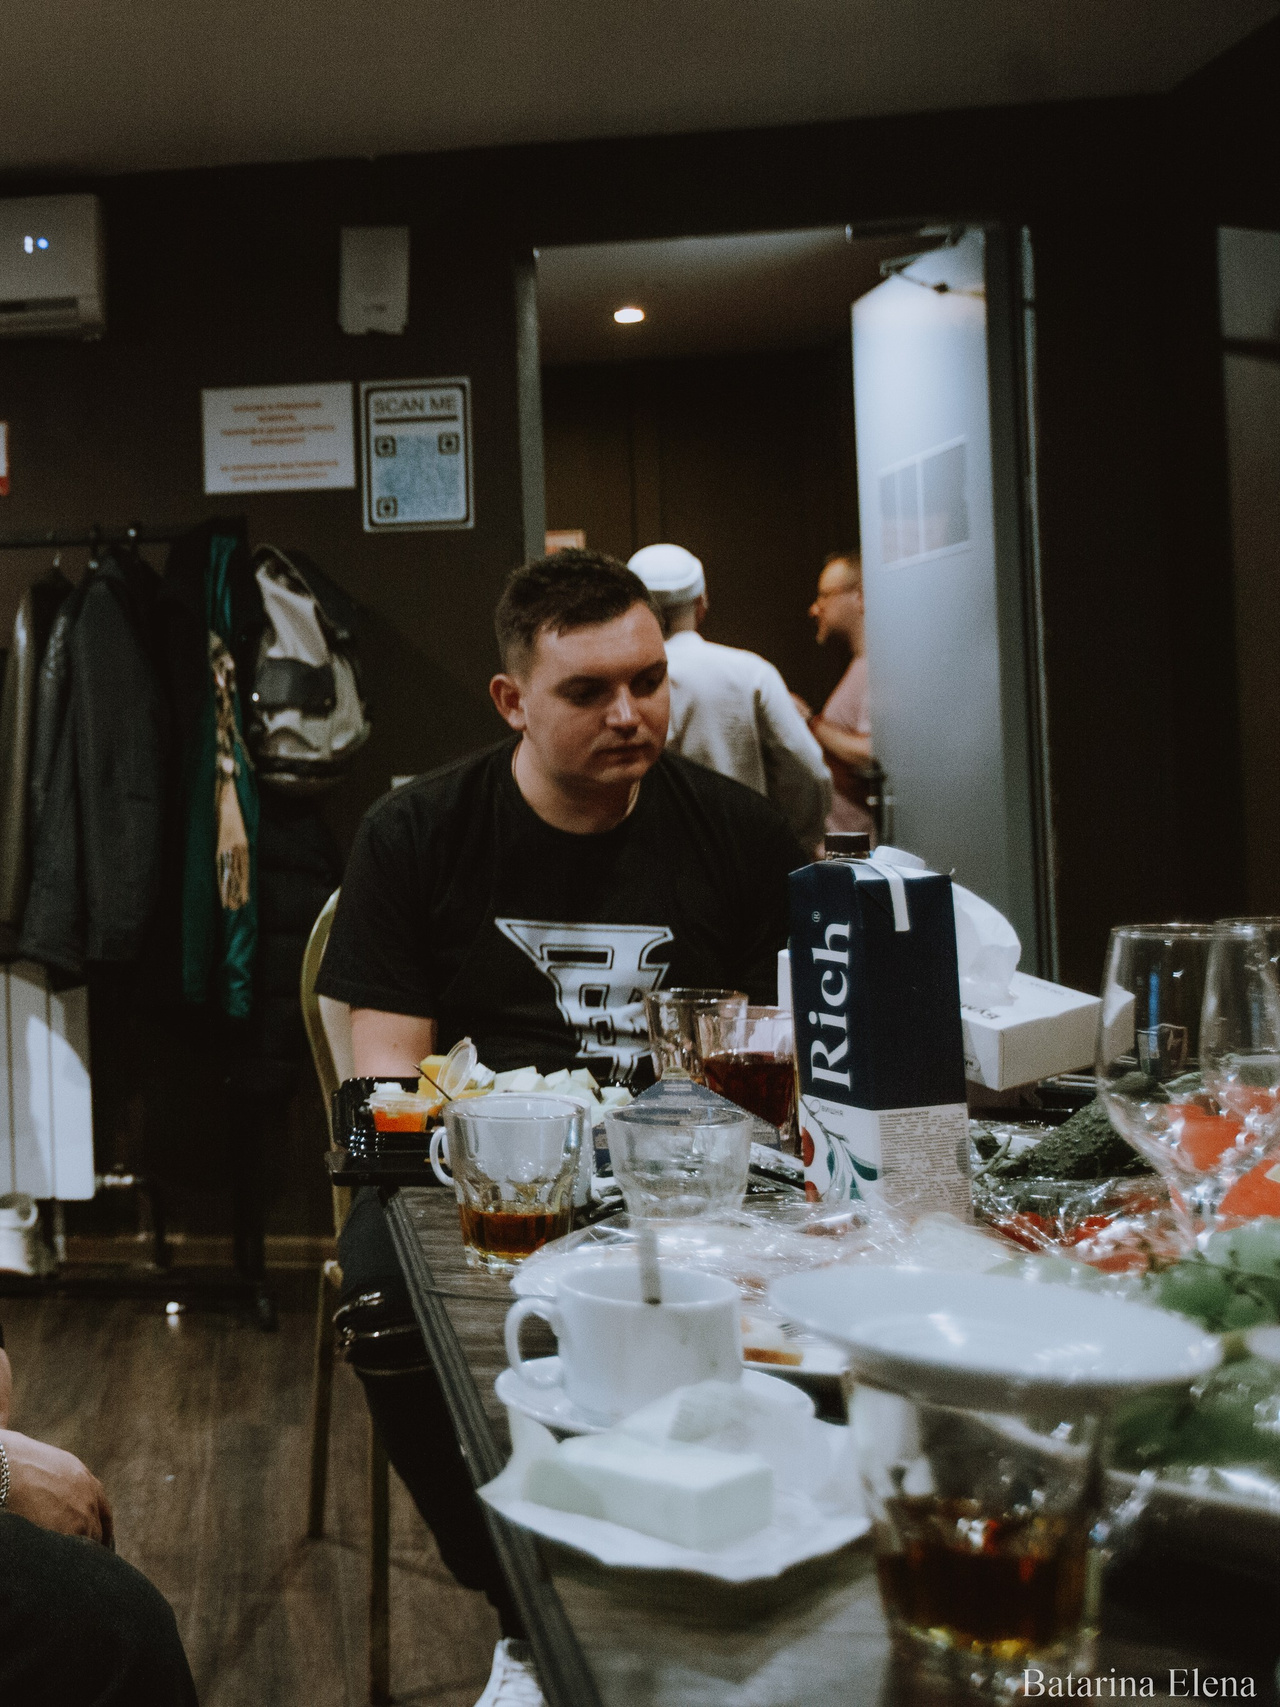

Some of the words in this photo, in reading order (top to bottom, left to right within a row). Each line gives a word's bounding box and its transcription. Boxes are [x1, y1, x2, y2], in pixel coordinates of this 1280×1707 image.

[374, 397, 425, 414] SCAN
[429, 394, 458, 411] ME
[809, 921, 851, 1092] Rich
